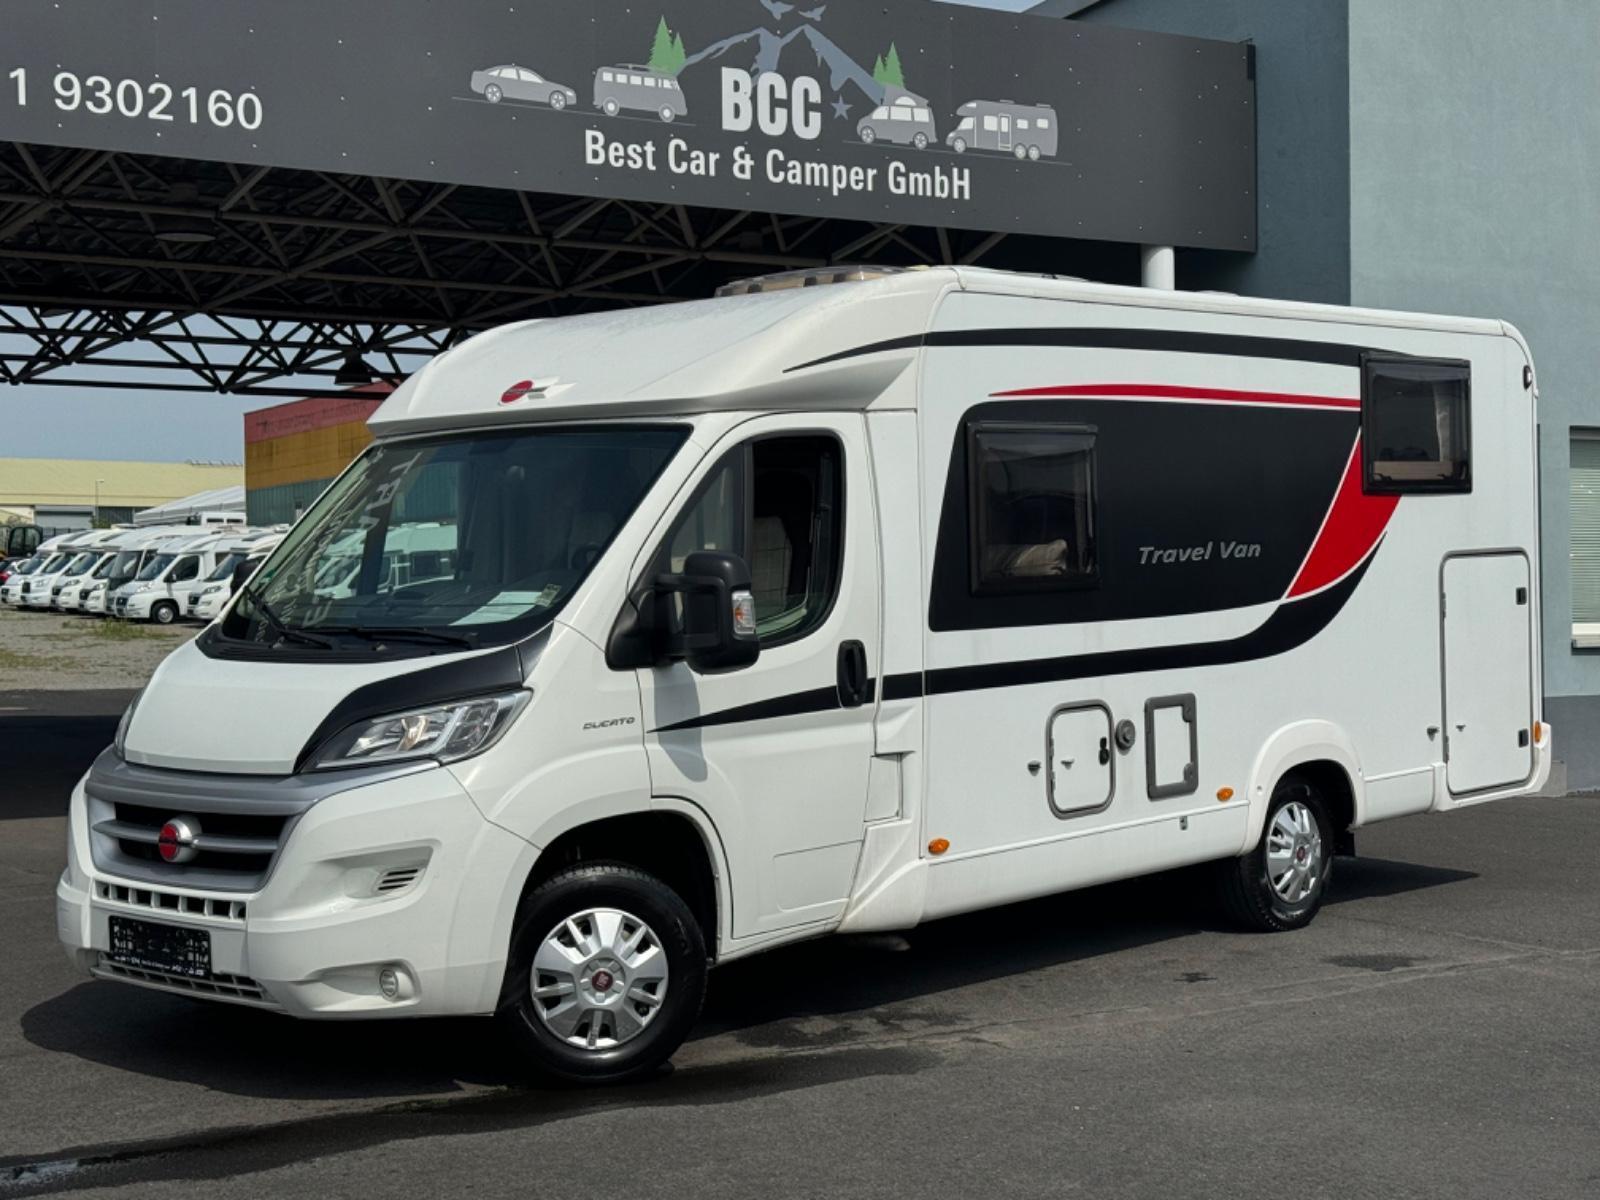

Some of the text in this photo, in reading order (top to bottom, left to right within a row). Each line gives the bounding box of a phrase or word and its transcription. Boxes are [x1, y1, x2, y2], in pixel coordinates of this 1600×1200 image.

[9, 67, 263, 130] 1 9302160
[721, 66, 822, 140] BCC
[585, 129, 970, 200] Best Car & Camper GmbH
[1138, 541, 1261, 565] Travel Van
[582, 716, 636, 730] DUCATO
